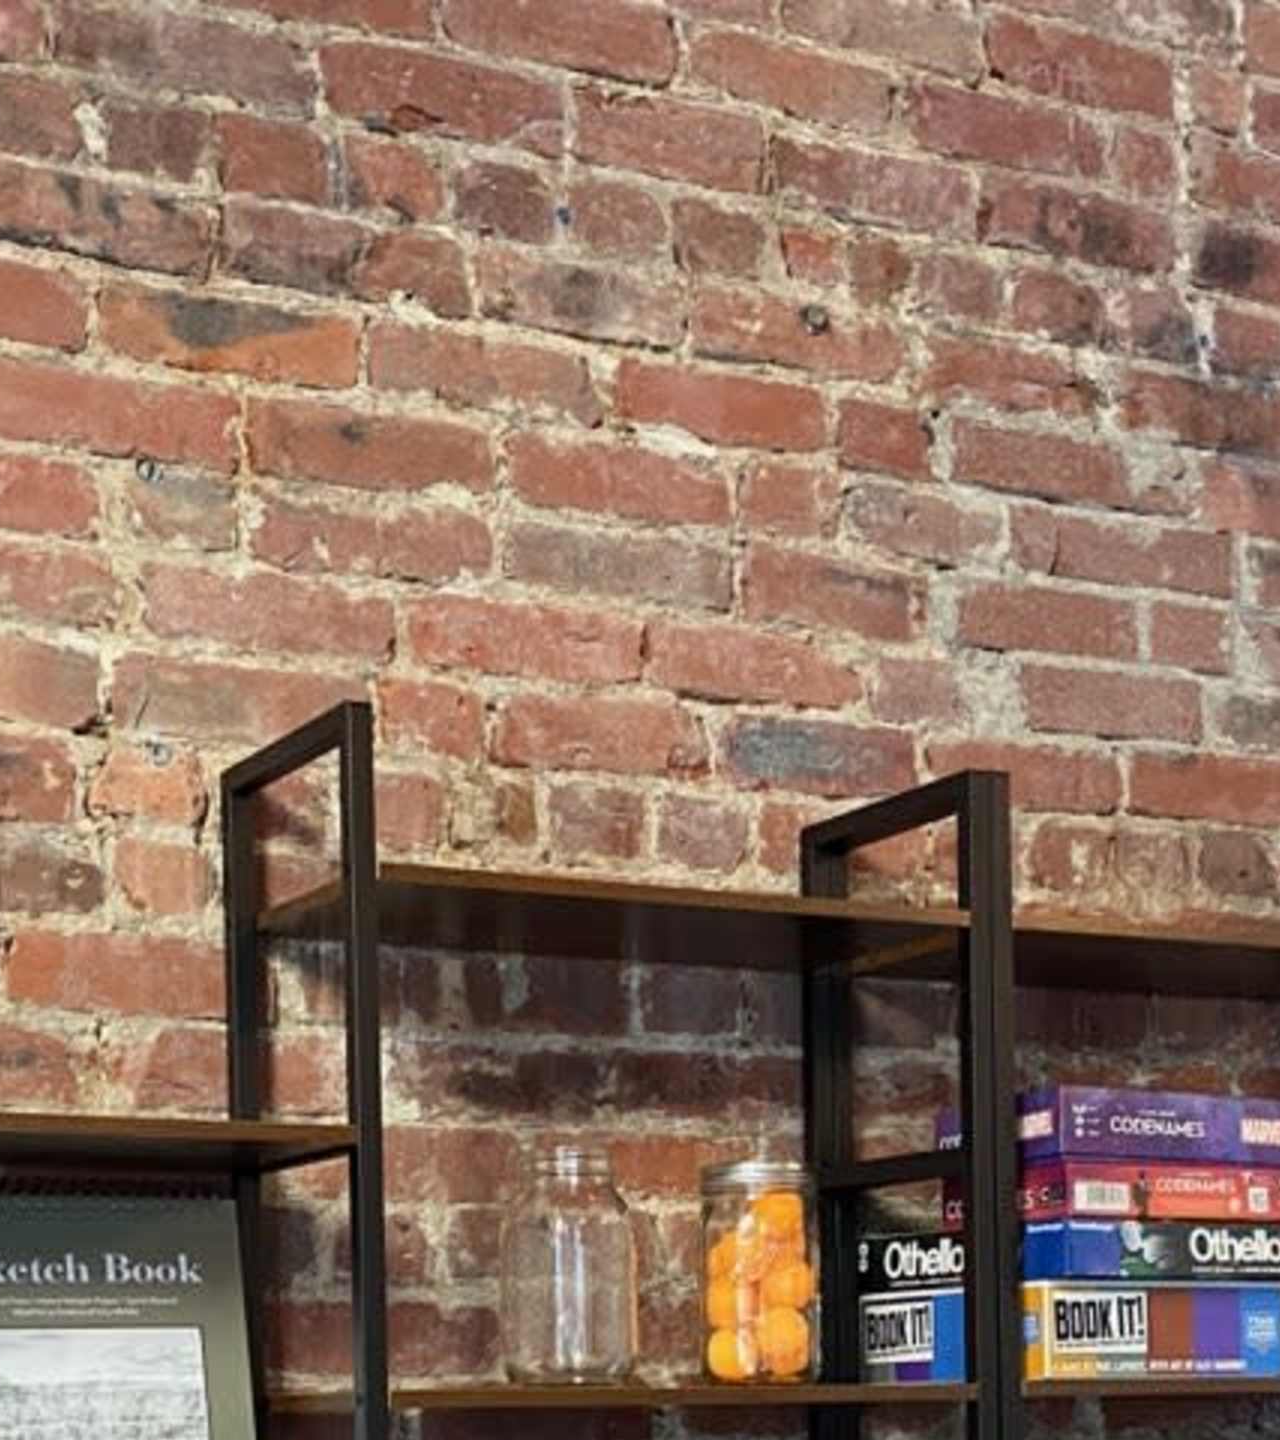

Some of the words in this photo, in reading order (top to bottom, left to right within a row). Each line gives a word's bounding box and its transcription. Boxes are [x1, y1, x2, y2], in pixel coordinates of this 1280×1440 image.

[1110, 1115, 1206, 1139] CODENAMES
[104, 1252, 203, 1284] Book
[884, 1238, 965, 1279] Othello
[867, 1307, 908, 1351] BOOK
[1054, 1298, 1113, 1341] BOOK
[1117, 1296, 1144, 1337] IT!
